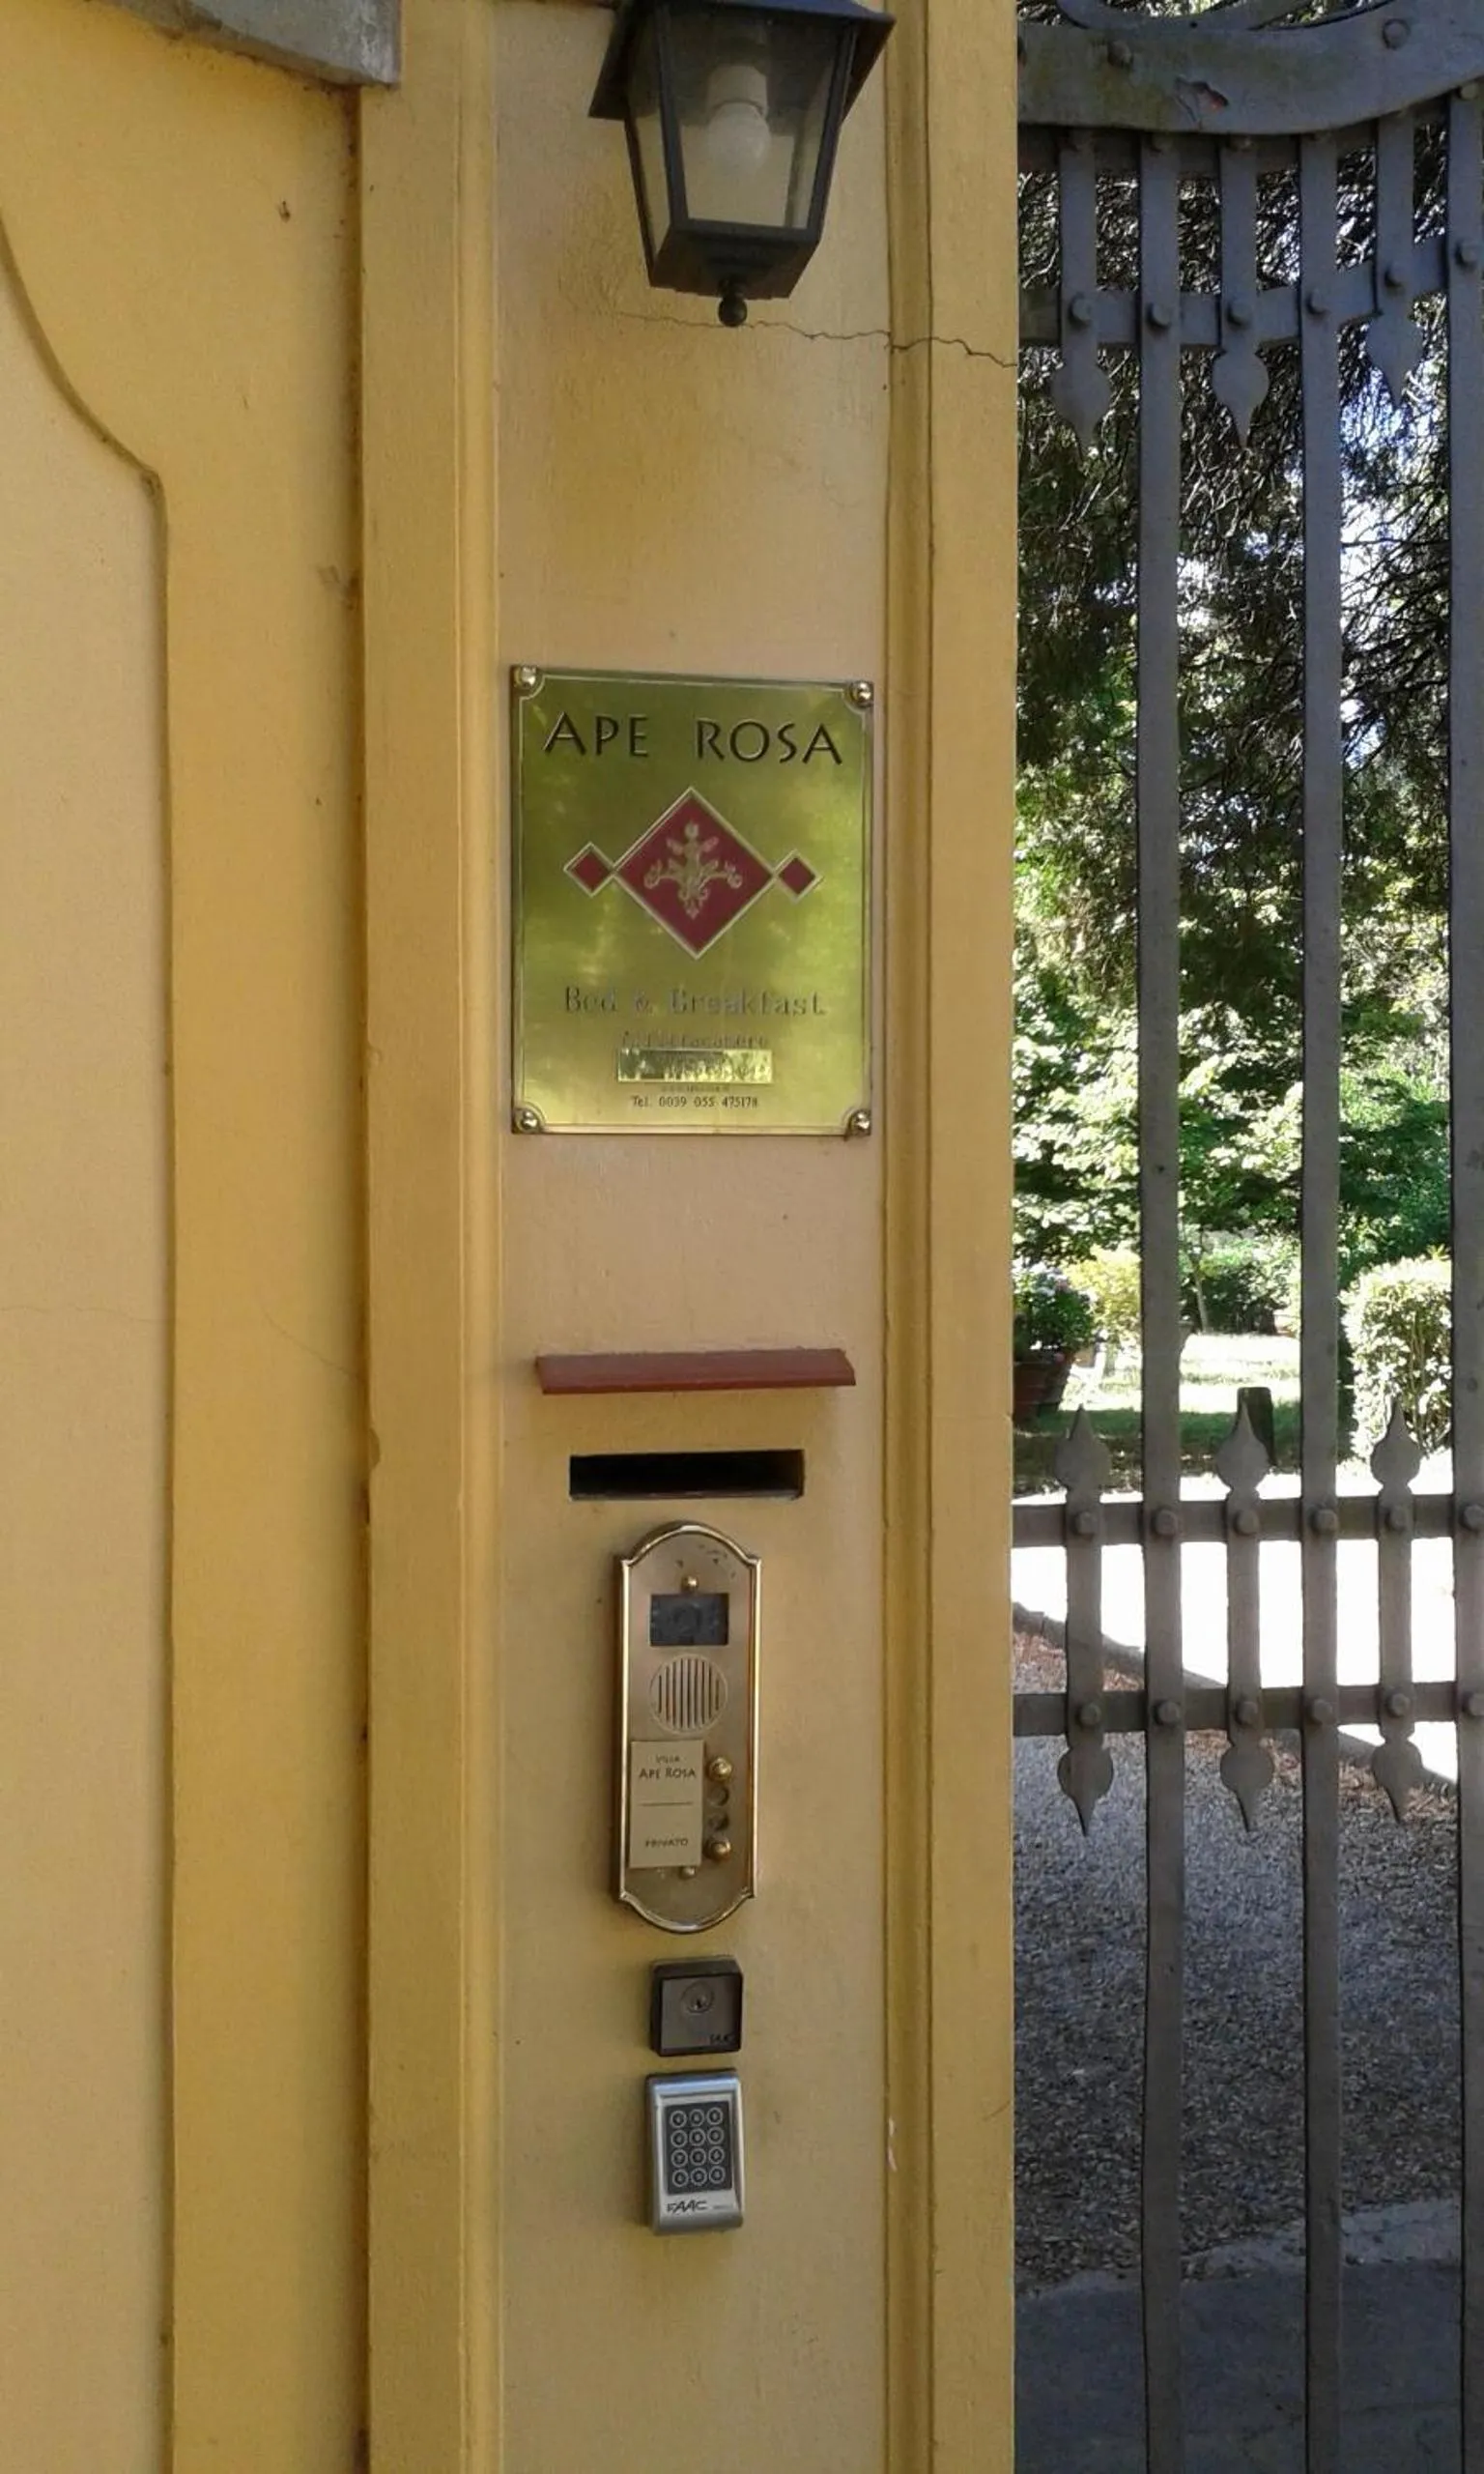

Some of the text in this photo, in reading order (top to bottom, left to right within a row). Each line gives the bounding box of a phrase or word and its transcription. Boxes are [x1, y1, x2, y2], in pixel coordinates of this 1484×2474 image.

[543, 710, 843, 765] APE ROSA
[564, 986, 618, 1014] Bed
[671, 987, 825, 1018] Breakfast
[639, 1768, 697, 1780] APE ROSA
